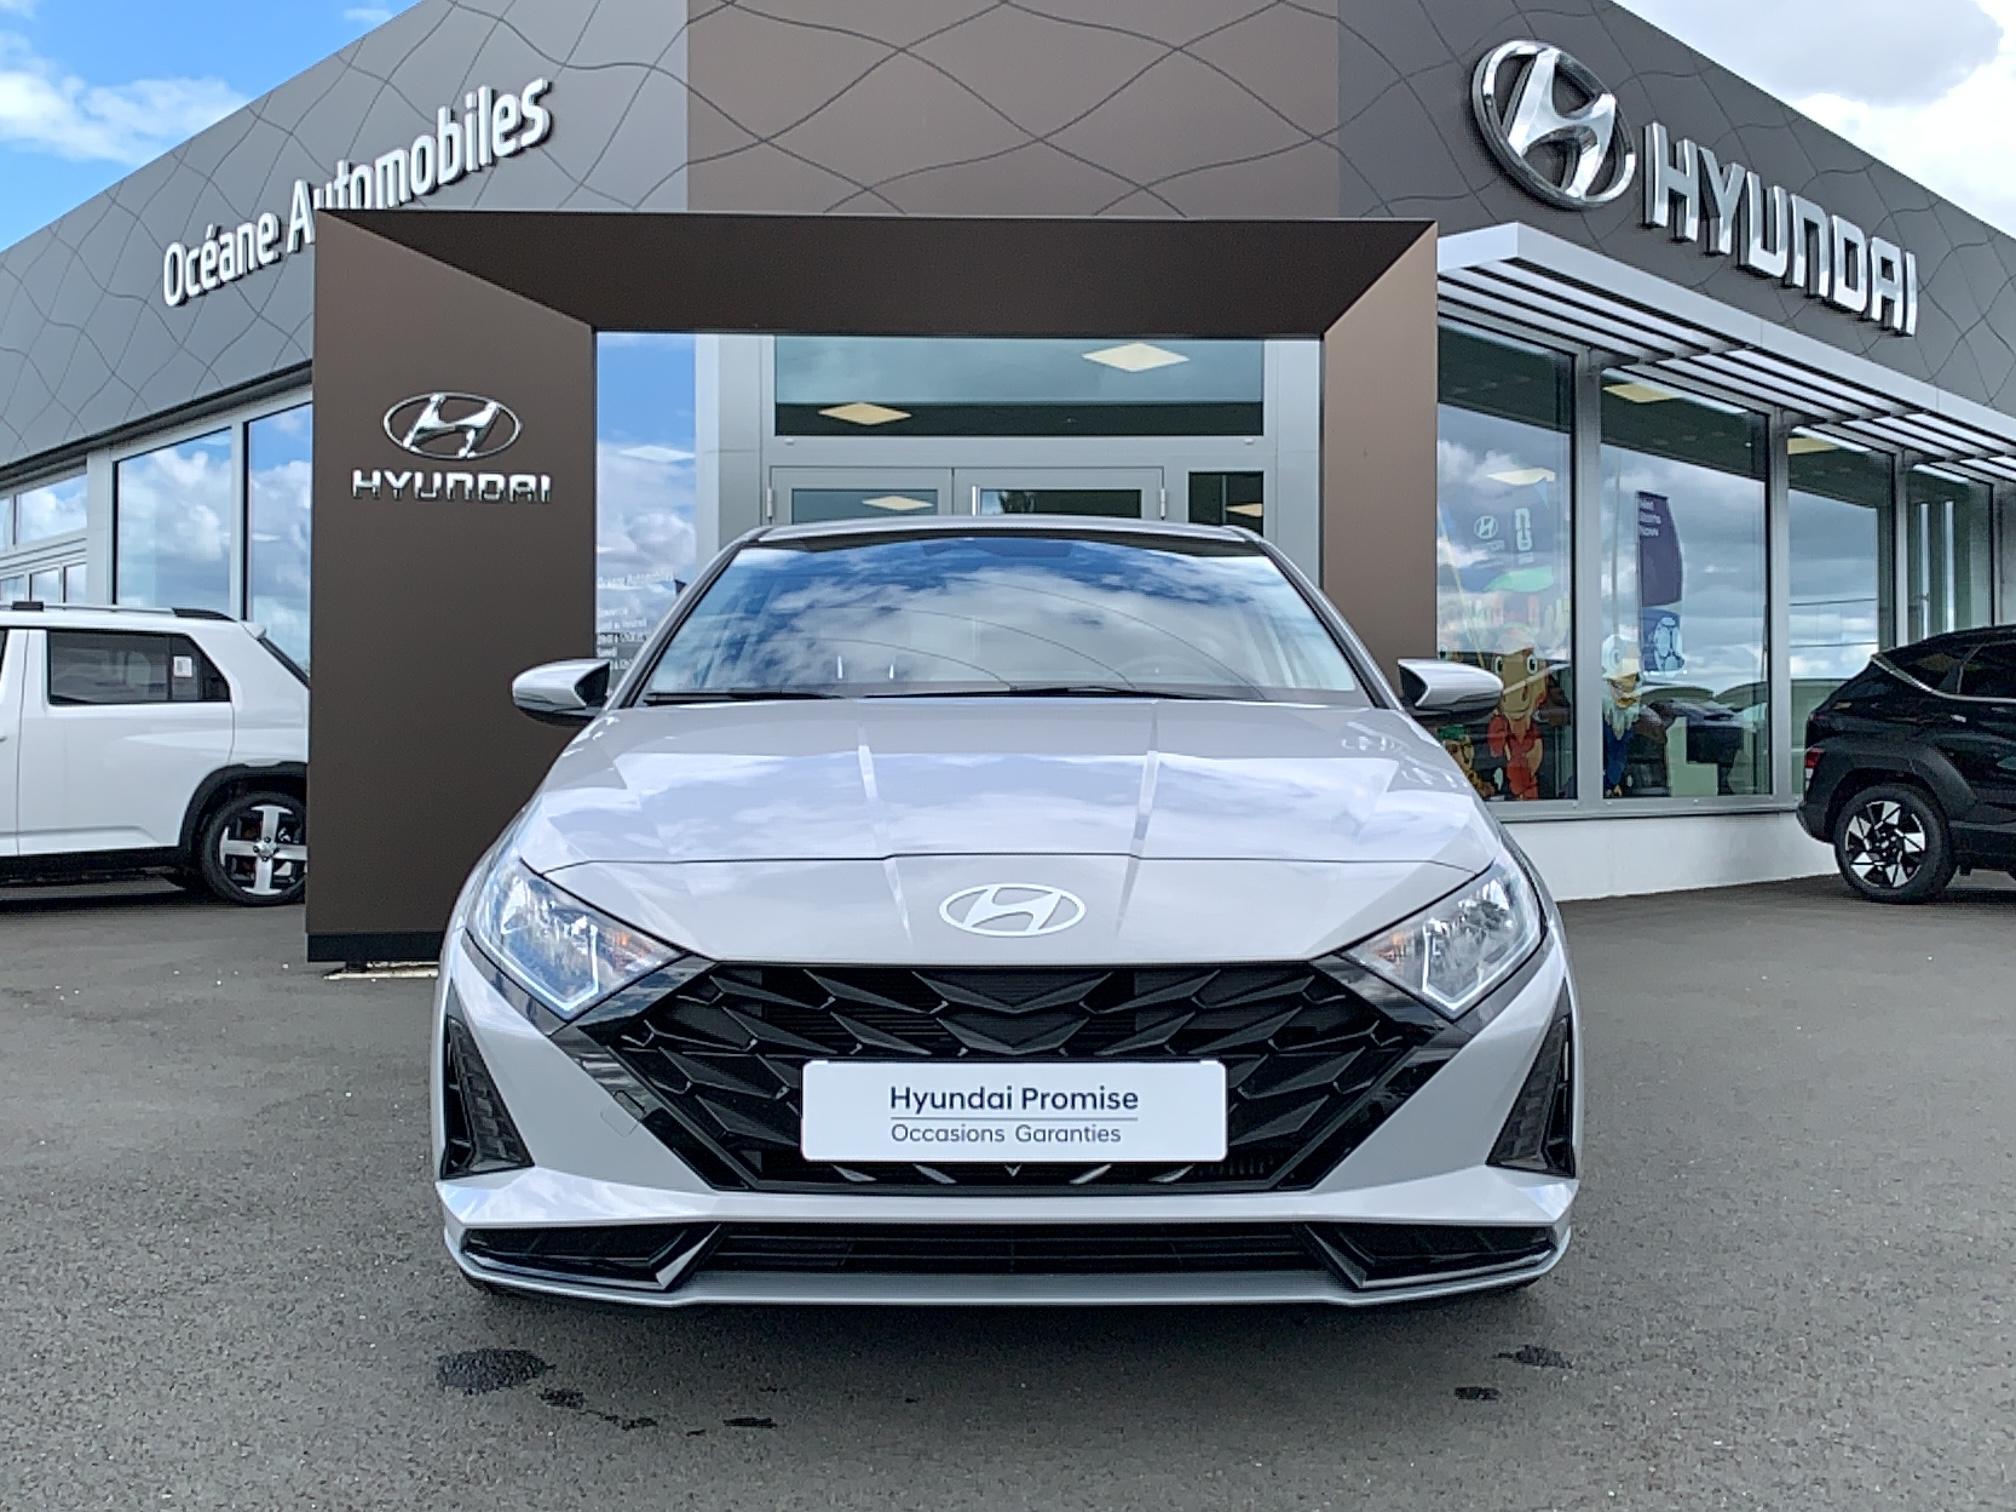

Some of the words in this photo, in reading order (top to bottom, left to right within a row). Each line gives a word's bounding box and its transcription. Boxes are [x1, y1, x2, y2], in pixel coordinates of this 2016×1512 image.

[1644, 121, 1918, 337] HYUNDAI
[163, 211, 281, 307] Océane
[352, 469, 551, 503] HYUNDAI
[890, 1085, 1013, 1115] Hyundai
[1021, 1085, 1139, 1110] Promise
[891, 1123, 1006, 1143] Occasions
[1014, 1123, 1122, 1143] Garanties
